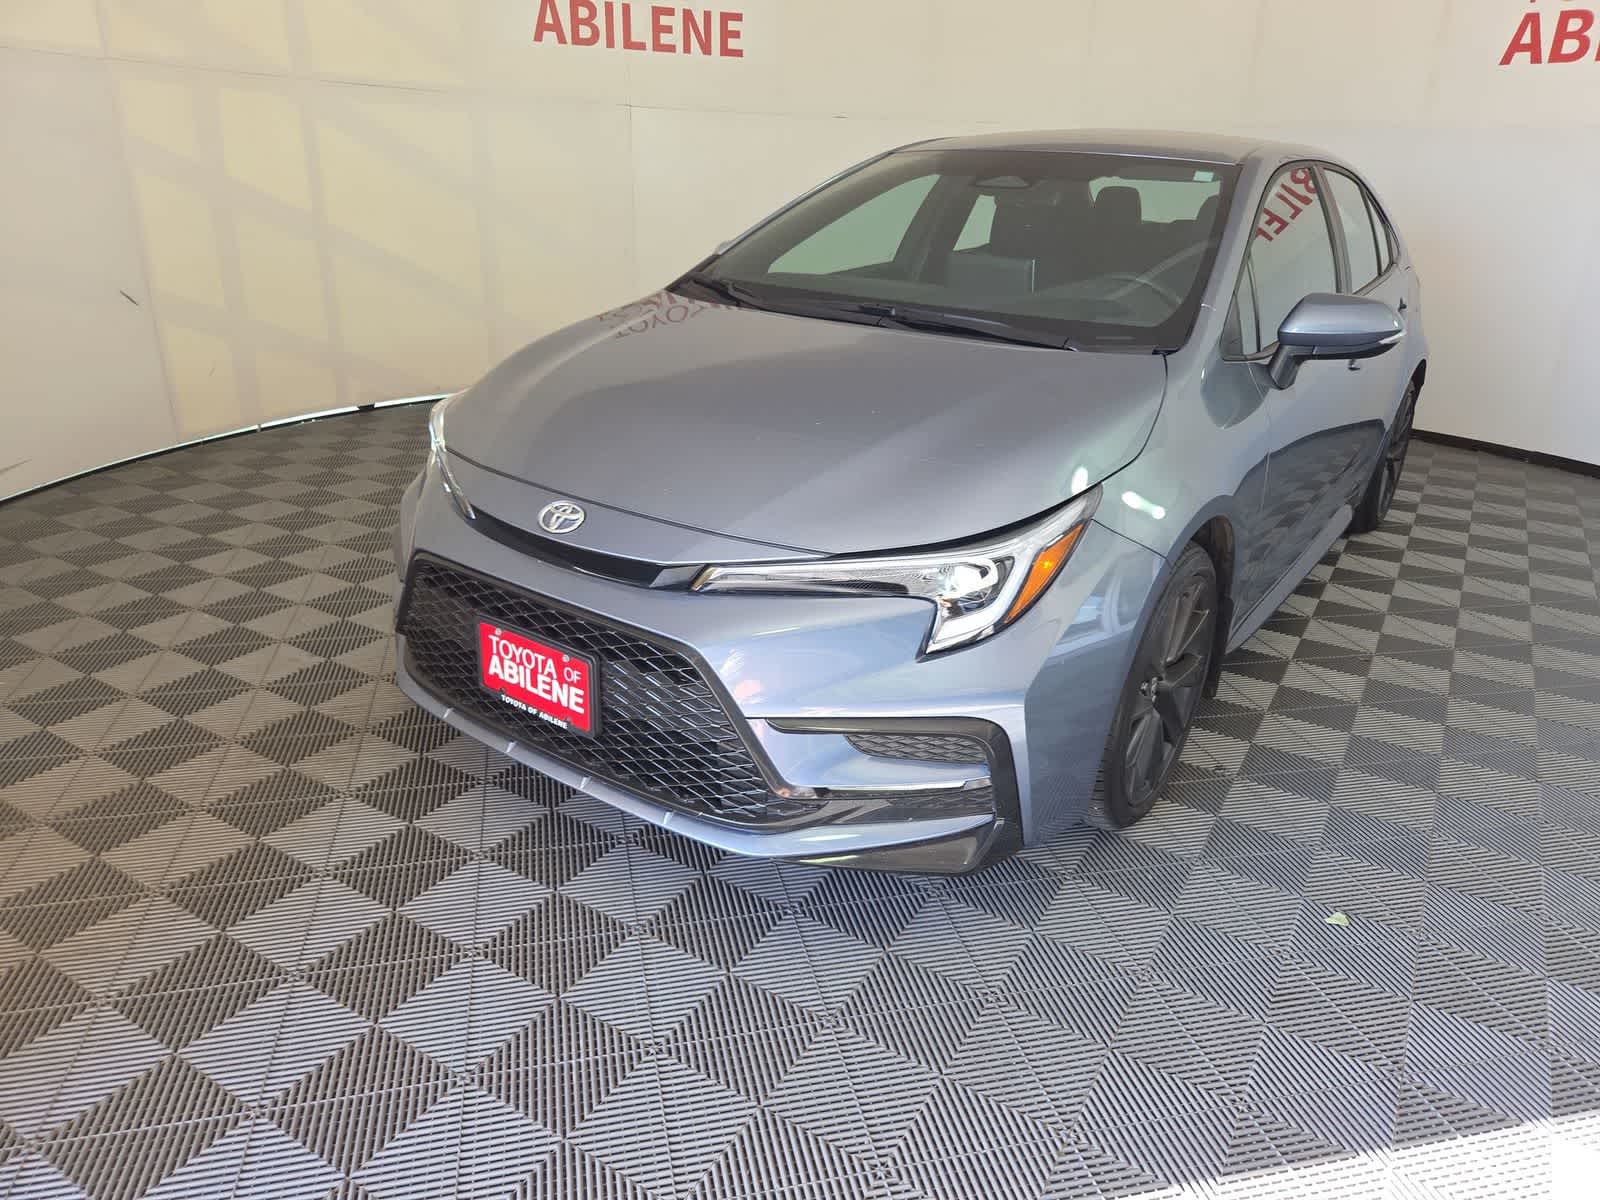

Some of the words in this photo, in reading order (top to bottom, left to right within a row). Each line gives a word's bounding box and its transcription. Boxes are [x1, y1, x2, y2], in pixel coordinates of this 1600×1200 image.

[533, 0, 744, 57] ABILENE
[1498, 9, 1600, 65] AB
[488, 634, 557, 679] TOYOTA
[563, 667, 582, 683] OF
[488, 655, 585, 714] ABILENE
[501, 694, 527, 711] TOYOTA
[527, 706, 538, 715] OF
[539, 711, 568, 729] ABILENE
